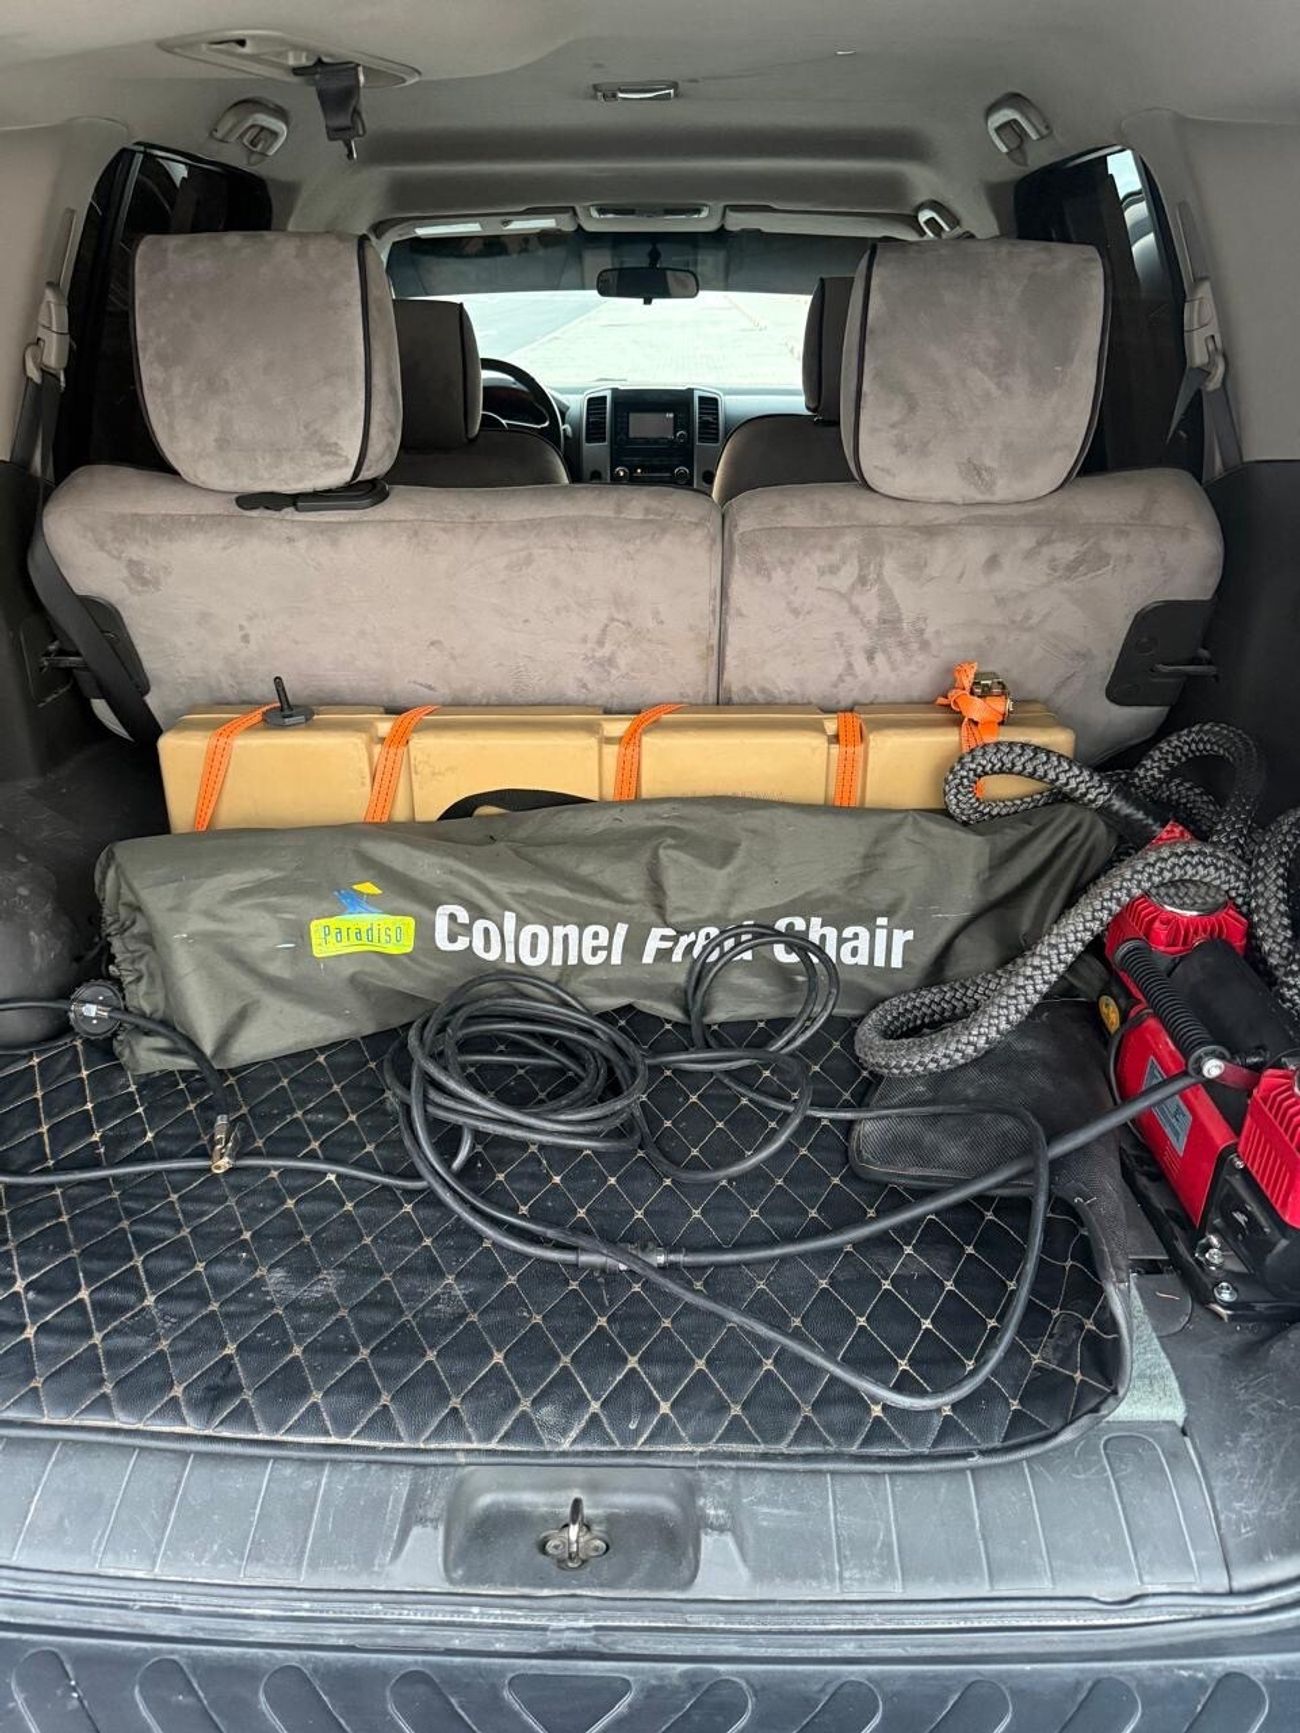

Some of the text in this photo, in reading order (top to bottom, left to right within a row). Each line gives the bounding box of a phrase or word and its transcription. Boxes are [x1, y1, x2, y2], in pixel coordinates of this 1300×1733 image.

[322, 922, 403, 946] Paradiso
[434, 904, 629, 966] Colonel
[773, 916, 914, 969] Chair
